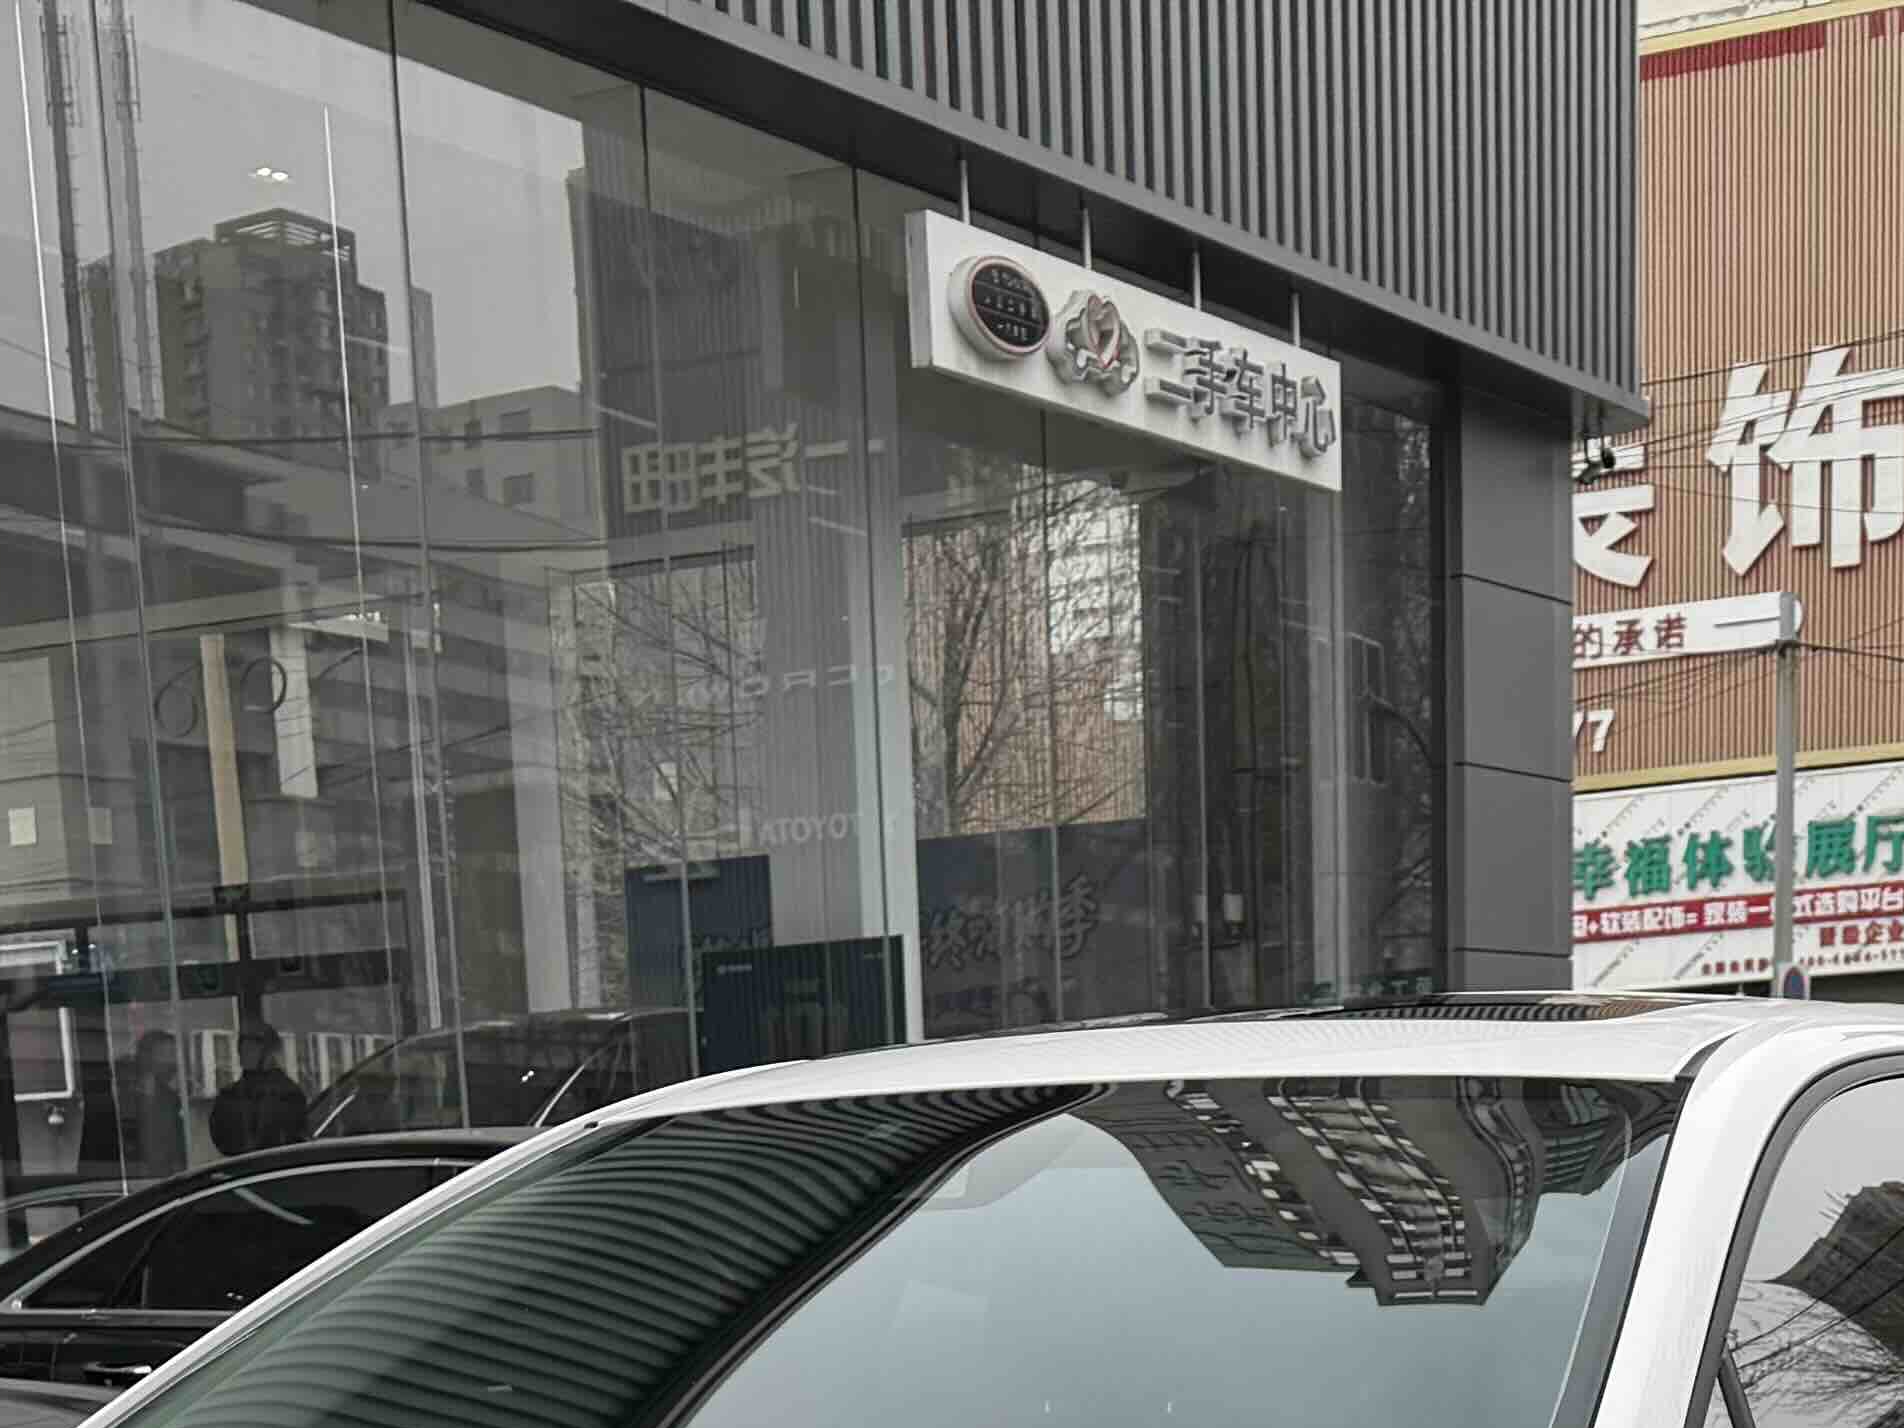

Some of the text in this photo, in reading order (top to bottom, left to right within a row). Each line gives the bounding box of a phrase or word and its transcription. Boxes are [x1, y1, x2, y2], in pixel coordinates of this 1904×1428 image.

[1144, 327, 1337, 458] 二手车中心
